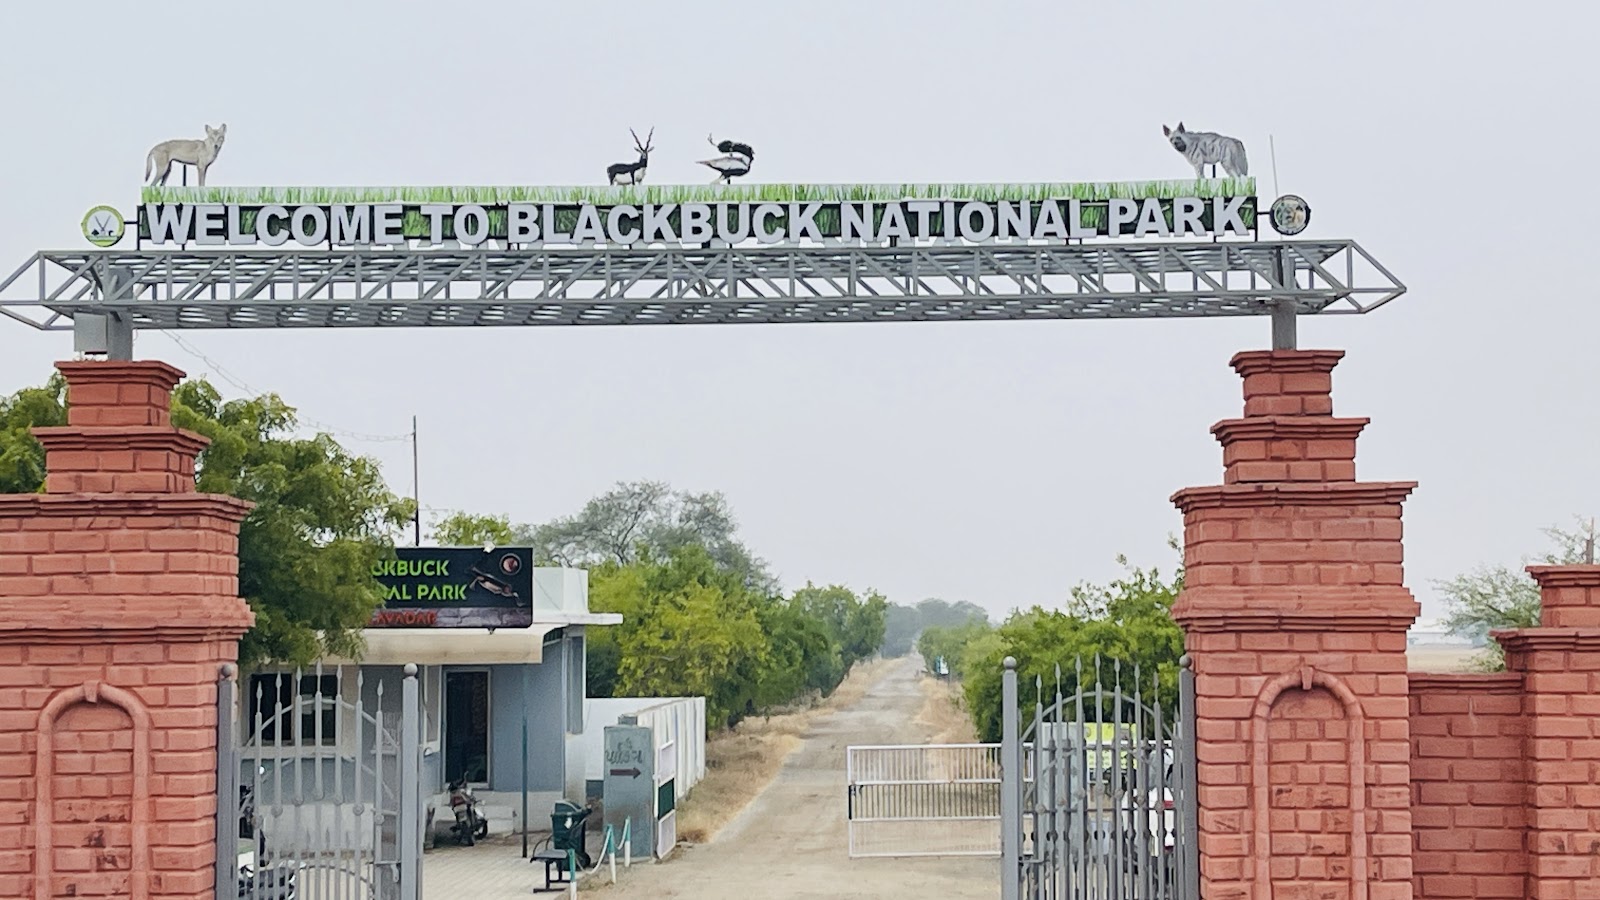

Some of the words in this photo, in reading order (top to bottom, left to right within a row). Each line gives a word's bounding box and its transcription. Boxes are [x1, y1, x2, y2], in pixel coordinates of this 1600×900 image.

[146, 203, 405, 246] WELCOME
[420, 203, 491, 245] TO
[507, 201, 826, 245] BLACKBUCK
[841, 198, 1098, 244] NATIONAL
[1108, 195, 1251, 239] PARK
[370, 559, 450, 577] CKBUCK
[417, 583, 468, 600] PARK
